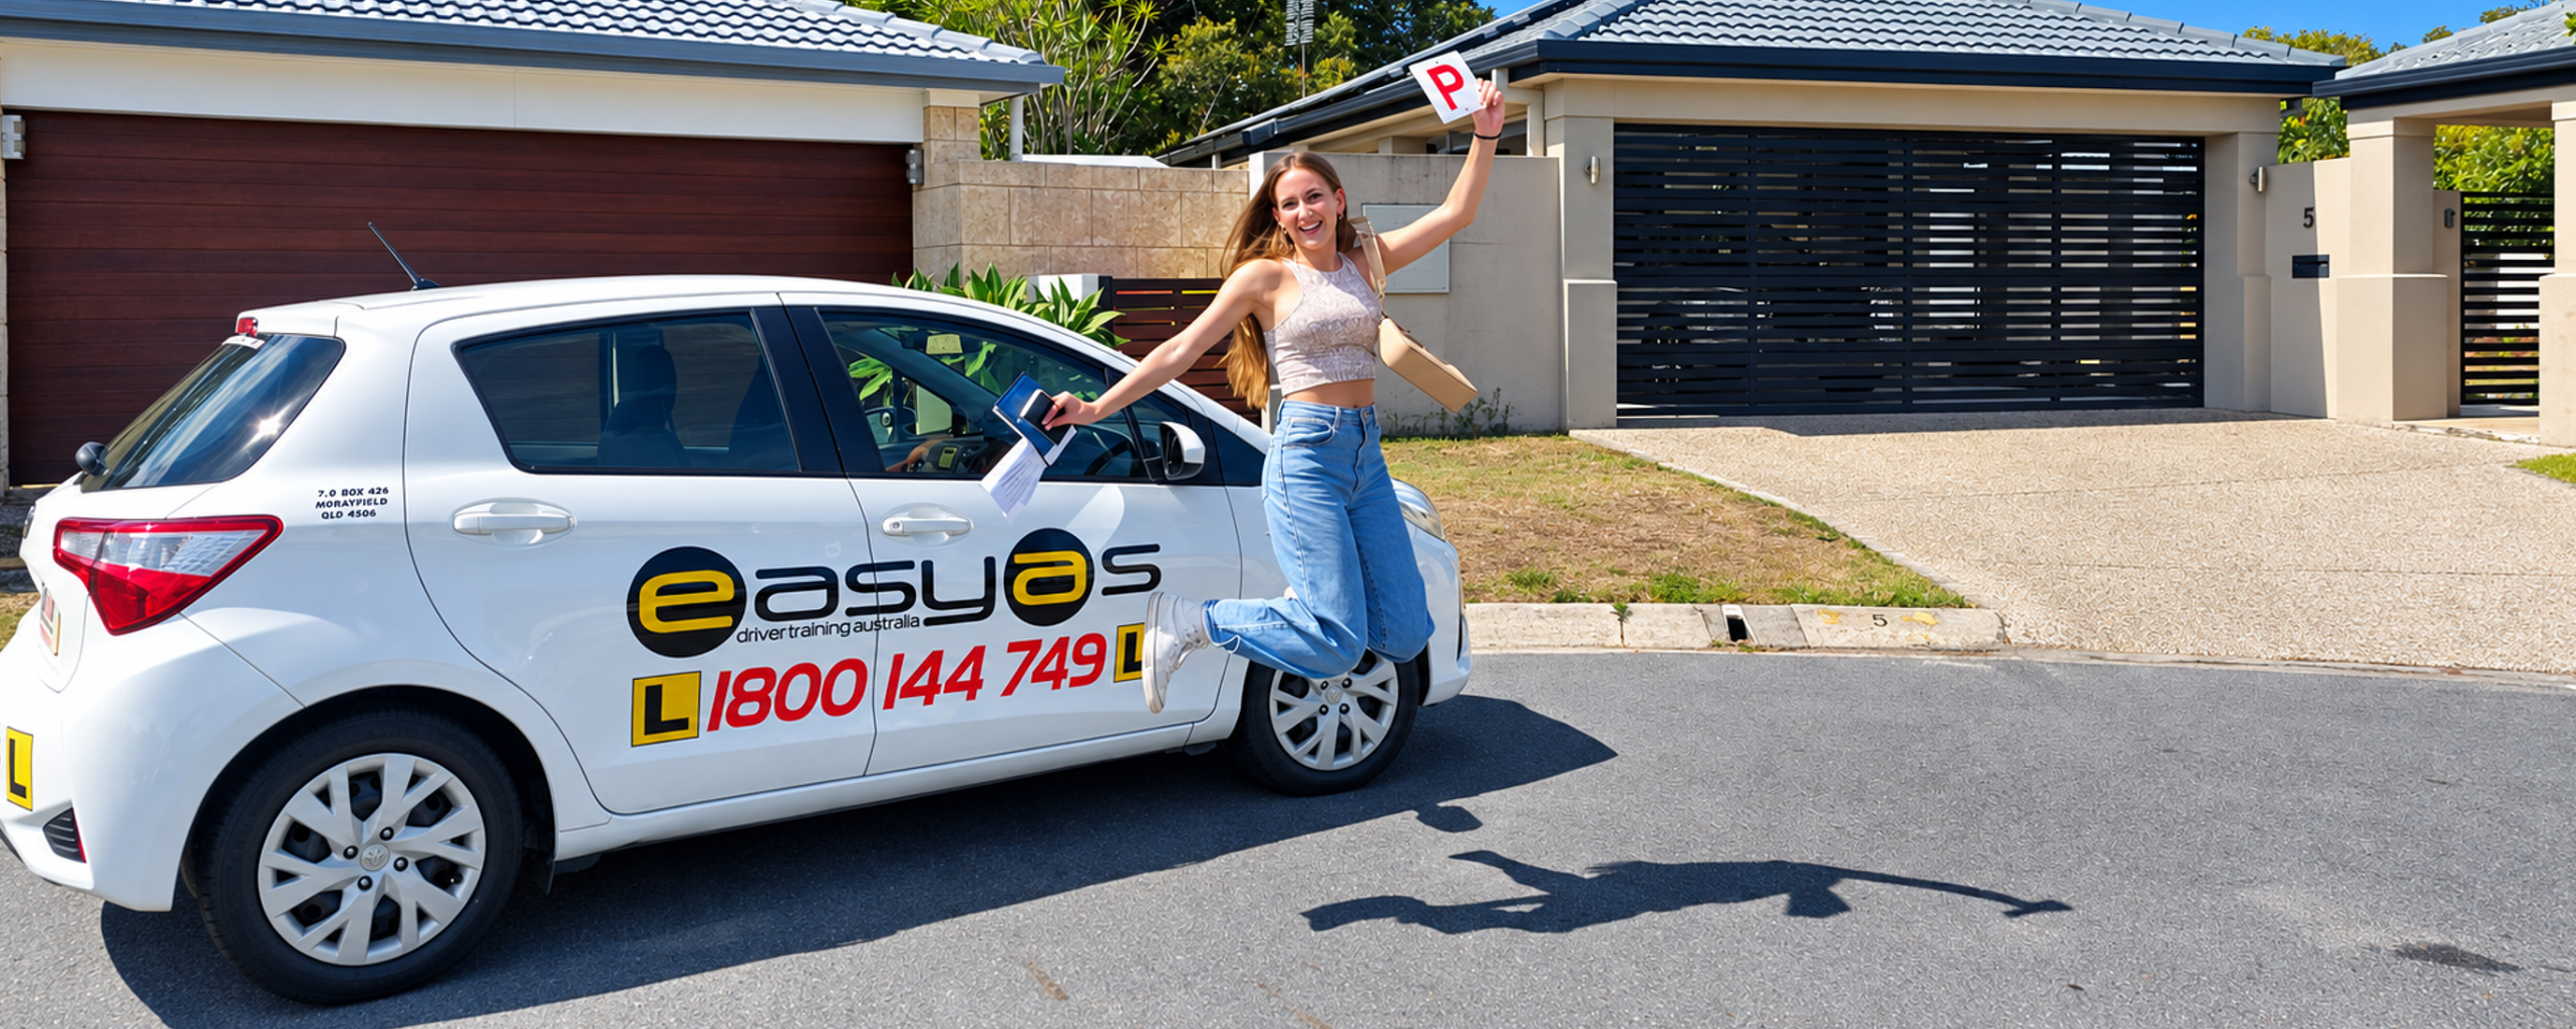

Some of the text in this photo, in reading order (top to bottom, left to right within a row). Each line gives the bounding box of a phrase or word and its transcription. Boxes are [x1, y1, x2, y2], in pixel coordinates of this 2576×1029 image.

[1427, 65, 1464, 110] P
[2303, 207, 2315, 228] 5
[342, 488, 364, 497] BOX
[368, 486, 389, 495] 426
[321, 509, 376, 520] QLD 4506
[1872, 614, 1888, 627] 5
[736, 628, 787, 643] driver
[789, 621, 851, 637] training
[706, 632, 1107, 732] 1800 144 749
[645, 684, 689, 735] L
[9, 738, 26, 799] L
